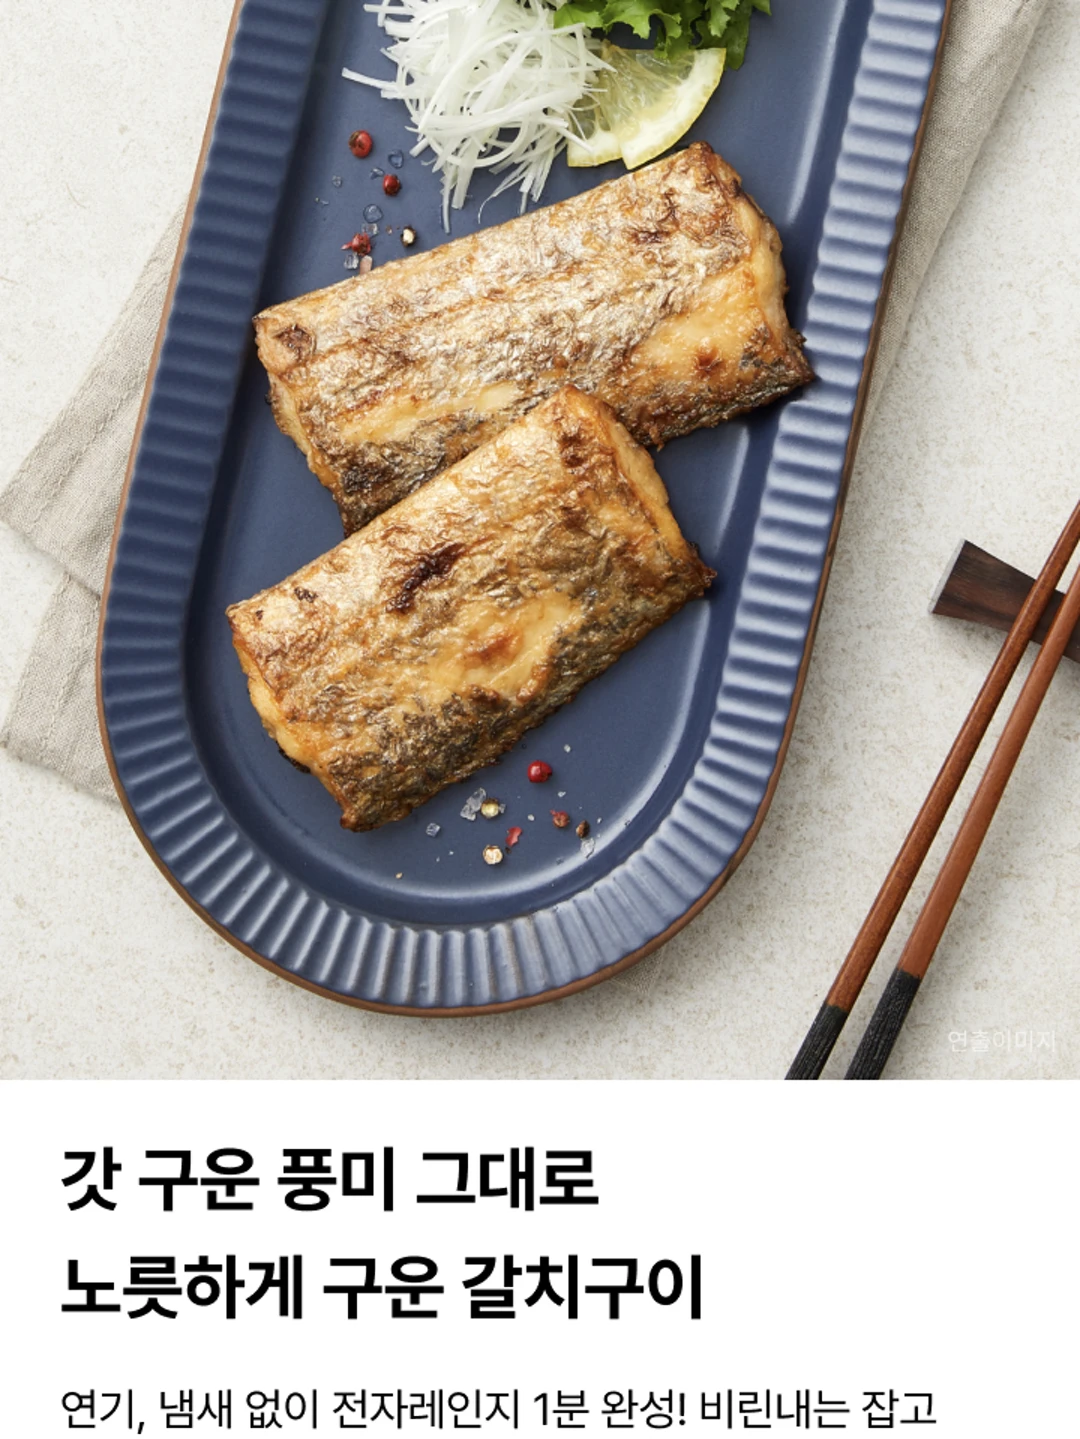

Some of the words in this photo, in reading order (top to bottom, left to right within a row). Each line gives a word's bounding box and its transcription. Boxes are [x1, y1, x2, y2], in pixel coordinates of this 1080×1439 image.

[61, 1146, 123, 1212] 갓
[138, 1147, 260, 1212] 구운
[277, 1146, 394, 1212] 풍미
[416, 1146, 600, 1212] 그대로
[61, 1254, 303, 1320] 노릇하게
[323, 1255, 445, 1320] 구운
[461, 1254, 702, 1320] 갈치구이
[61, 1388, 145, 1435] 연기,
[160, 1388, 232, 1430] 냄새
[245, 1388, 317, 1430] 없이
[332, 1388, 519, 1430] 전자레인지
[534, 1389, 590, 1429] 1분
[601, 1388, 686, 1429] 완성!
[701, 1388, 850, 1430] 비린내는
[862, 1388, 937, 1429] 잡고
